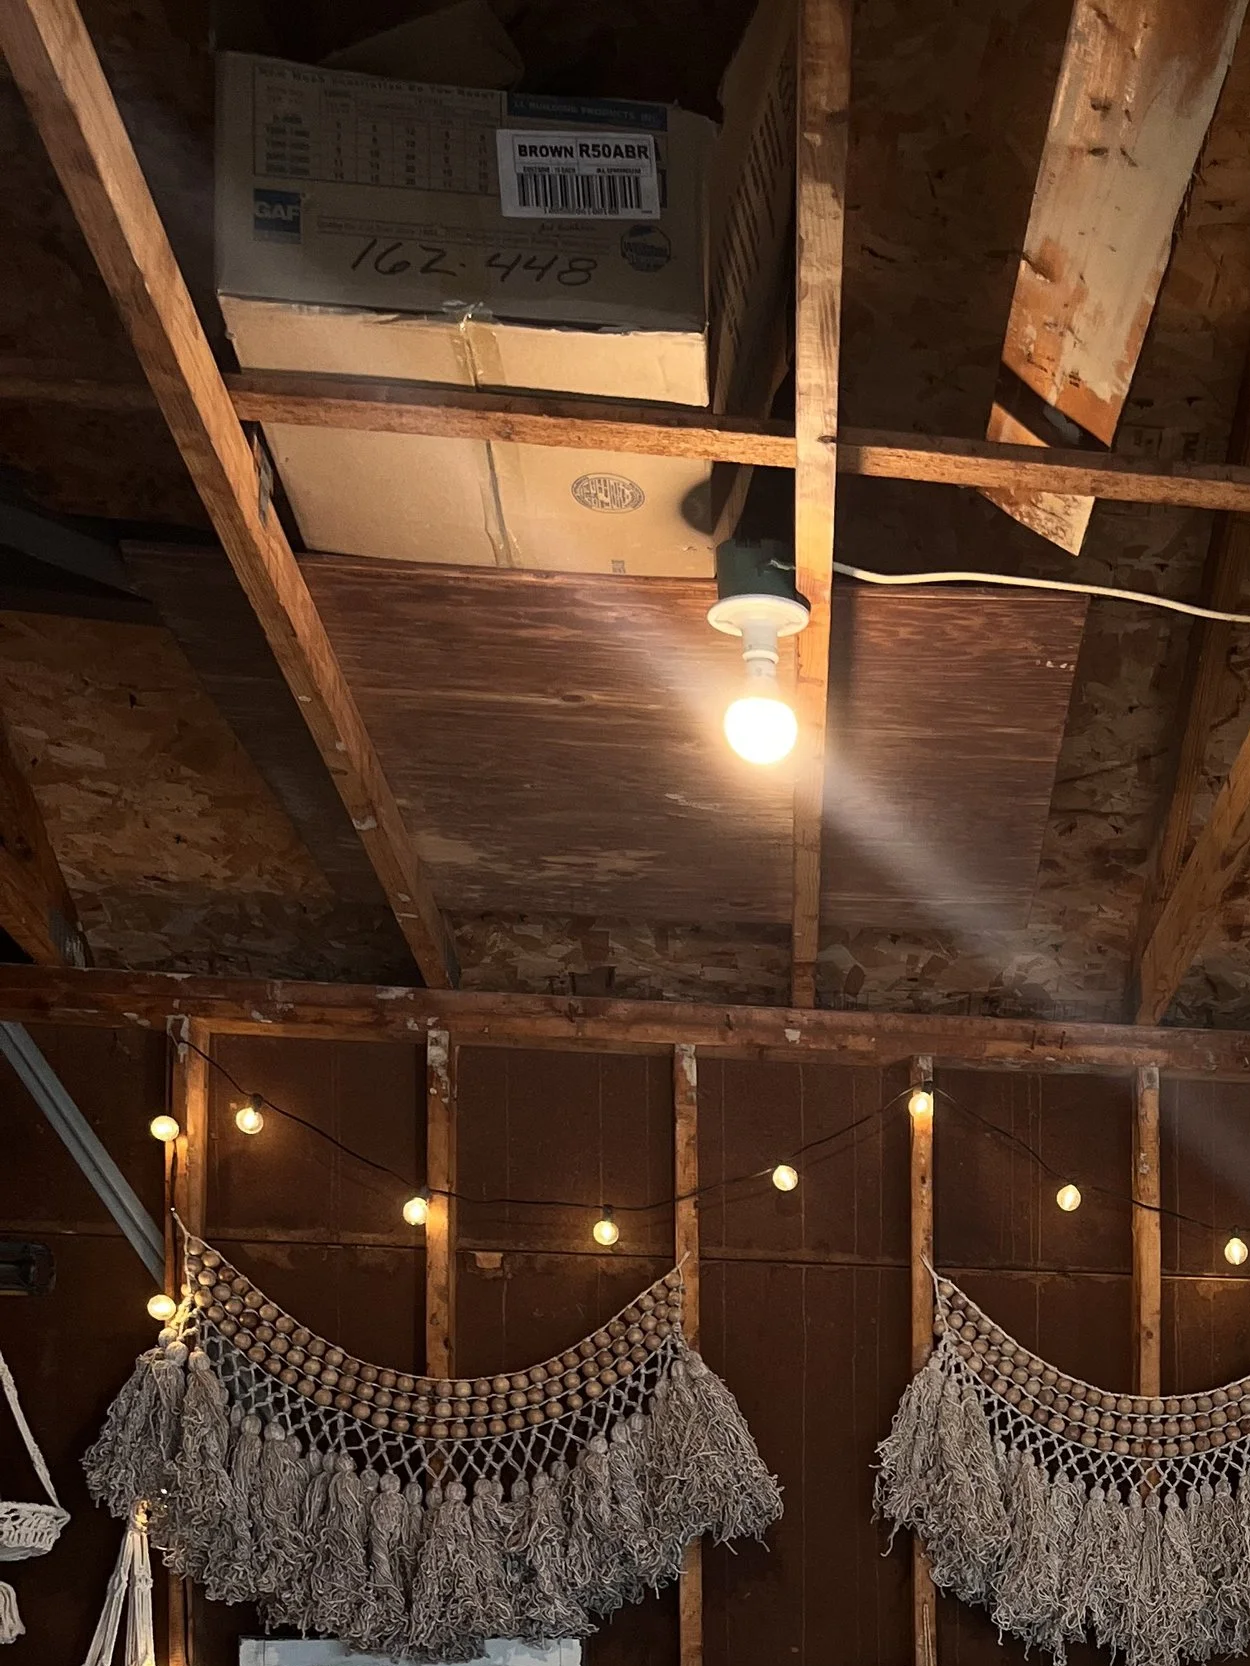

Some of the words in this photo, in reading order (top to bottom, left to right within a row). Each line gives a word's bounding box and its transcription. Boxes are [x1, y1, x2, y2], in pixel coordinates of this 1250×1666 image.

[517, 143, 574, 159] BROWN
[578, 142, 649, 160] R50ABR
[255, 200, 300, 221] GAF
